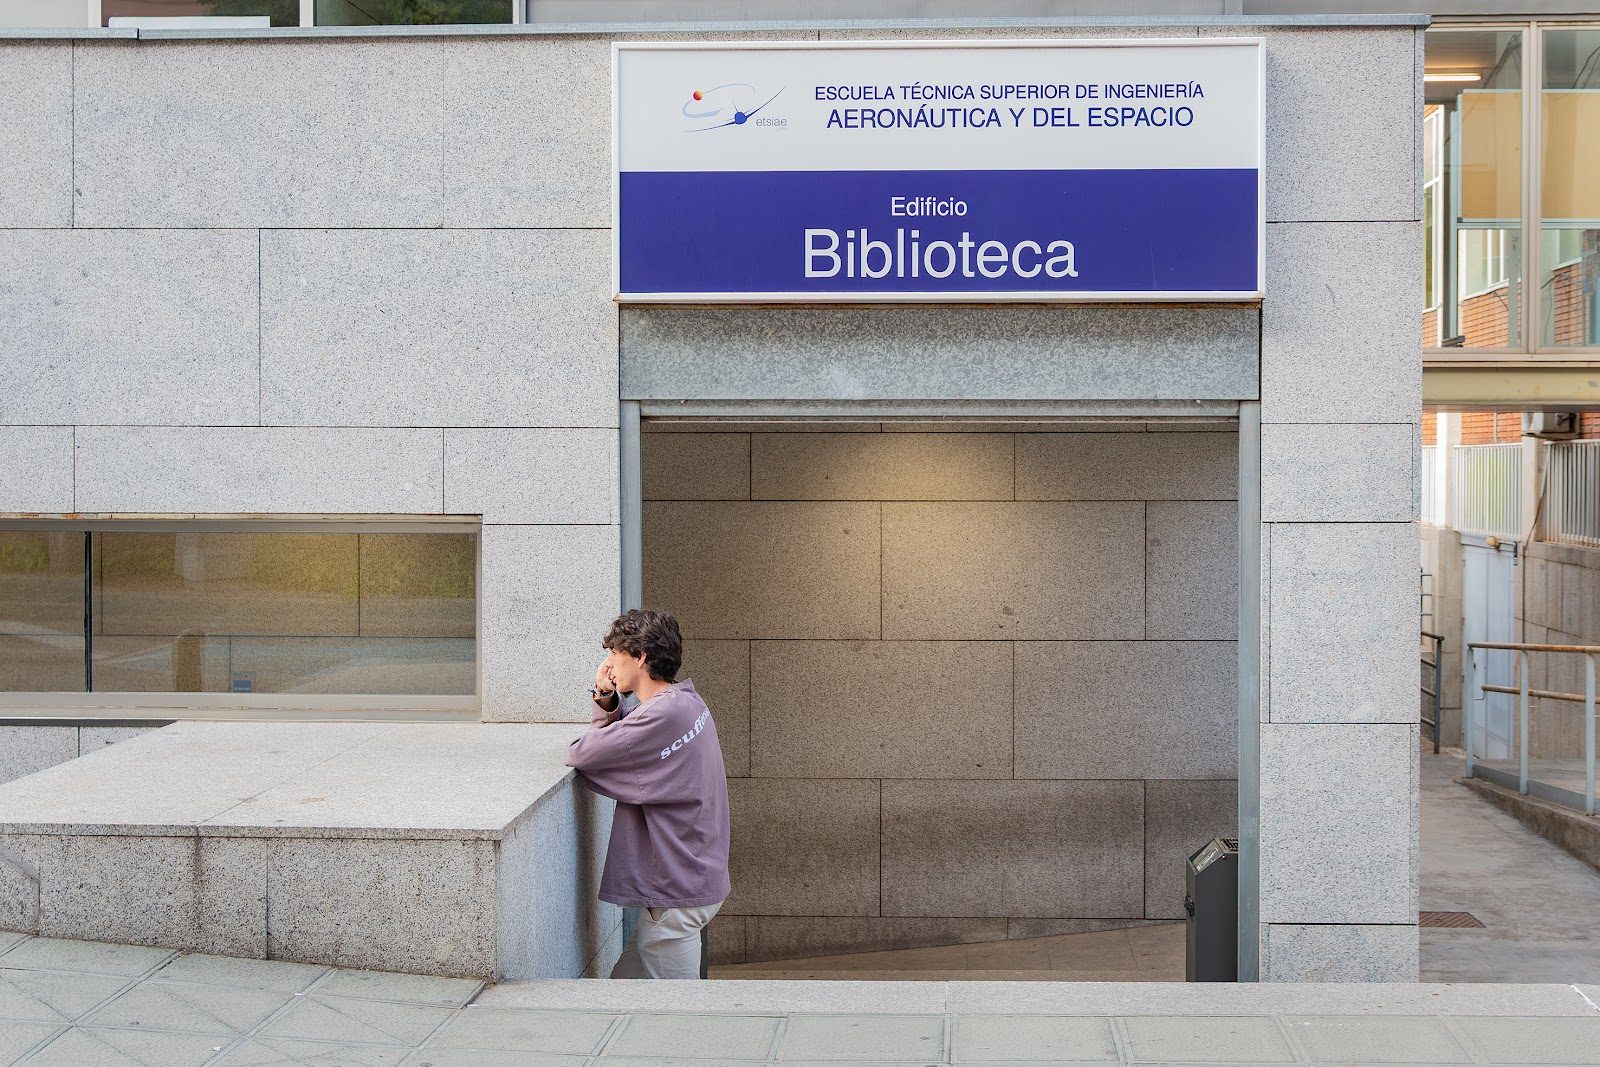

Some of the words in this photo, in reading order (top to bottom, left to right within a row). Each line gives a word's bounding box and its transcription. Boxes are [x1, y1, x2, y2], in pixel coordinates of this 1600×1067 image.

[815, 85, 895, 101] ESCUELA
[899, 82, 976, 100] TÉCNICA
[979, 84, 1070, 100] SUPERIOR
[1075, 84, 1099, 99] DE
[1104, 81, 1205, 99] INGENIERÍA
[755, 116, 788, 127] etsiae
[826, 103, 1002, 129] AERONÁUTICA
[1008, 107, 1026, 128] Y
[1033, 107, 1080, 128] DEL
[1088, 106, 1194, 128] ESPACIO
[891, 196, 968, 217] Edificio
[804, 228, 1079, 279] Biblioteca
